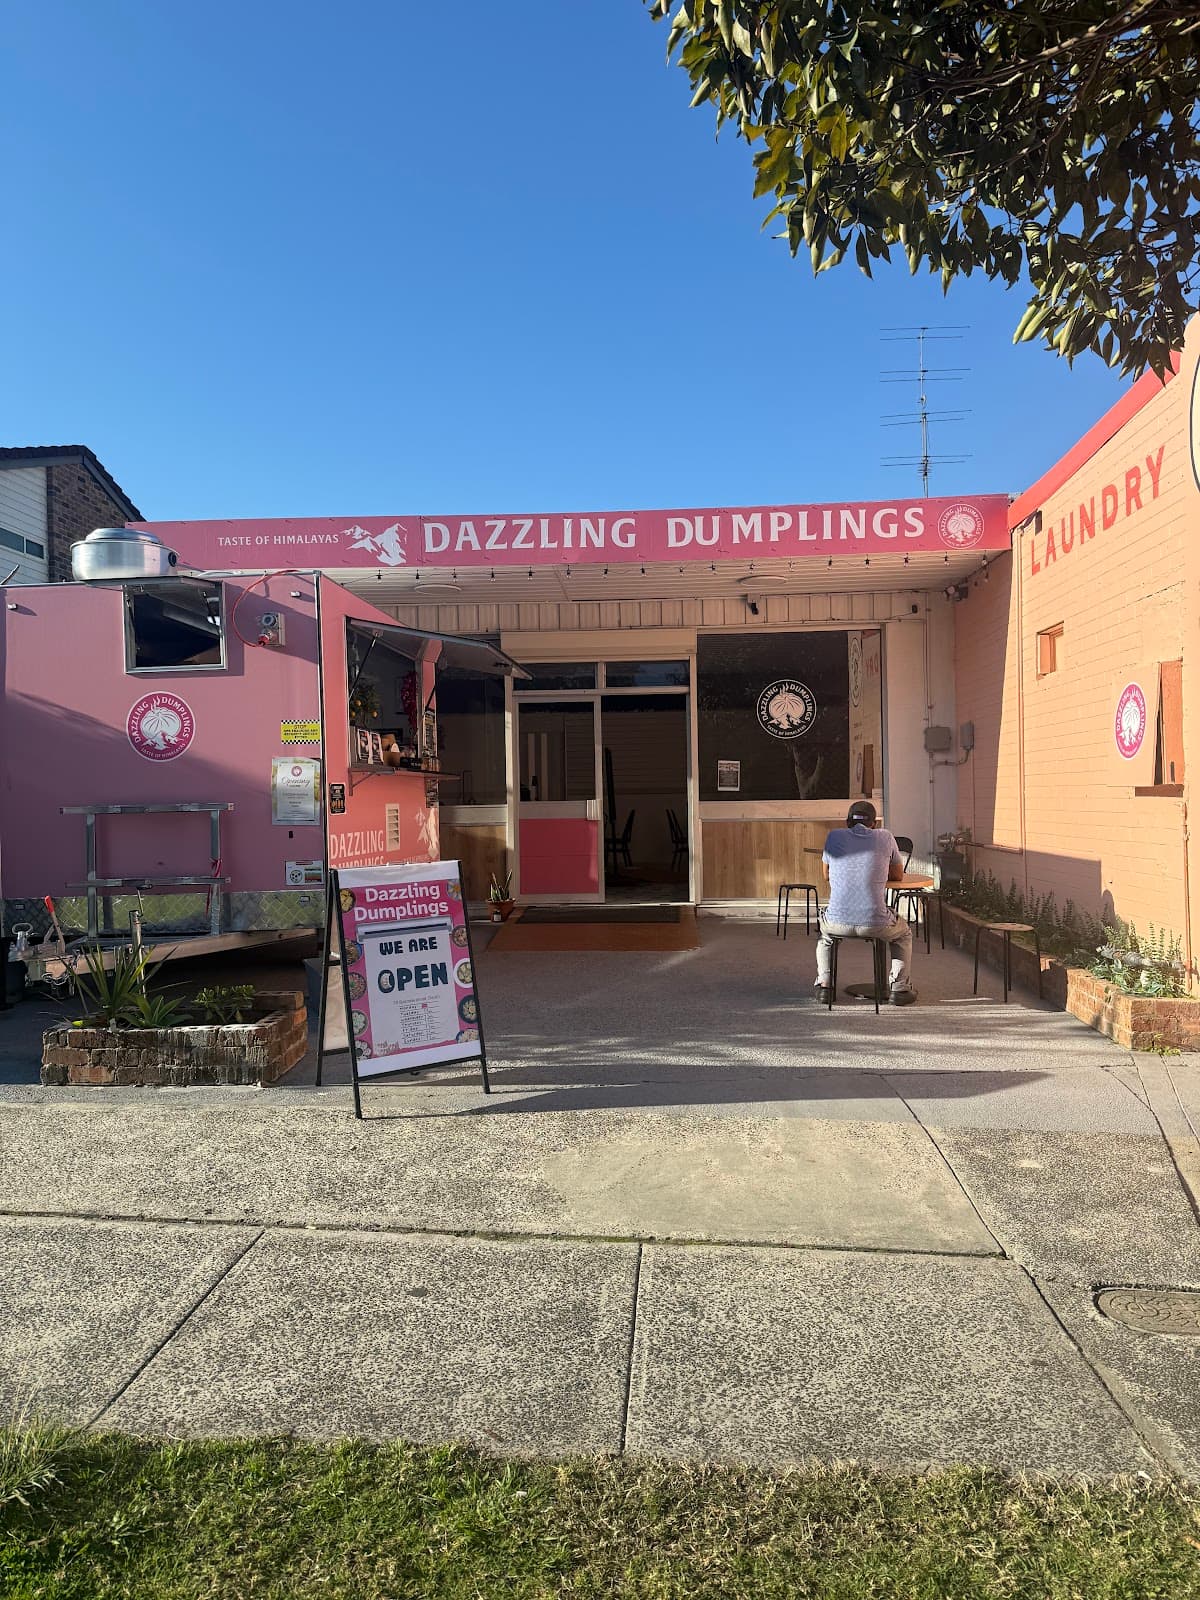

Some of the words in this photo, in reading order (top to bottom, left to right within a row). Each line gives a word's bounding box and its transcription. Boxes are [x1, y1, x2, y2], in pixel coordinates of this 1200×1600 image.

[1030, 445, 1166, 577] LAUNDRY
[217, 536, 252, 546] TASTE
[255, 536, 270, 545] OF
[273, 534, 339, 545] HIMALAYAS
[424, 518, 636, 553] DAZZLING
[666, 508, 925, 548] DUMPLINGS
[760, 686, 779, 722] DAZZLING
[790, 684, 813, 722] DUMPLINGS
[130, 701, 149, 743] DAZZLING
[161, 696, 191, 738] DUMPLINGS
[330, 830, 384, 860] DAZZLING
[365, 882, 440, 902] Dazzling
[354, 900, 448, 921] Dumplings
[380, 940, 404, 956] WE
[408, 936, 438, 952] ARE
[378, 962, 448, 994] OPEN
